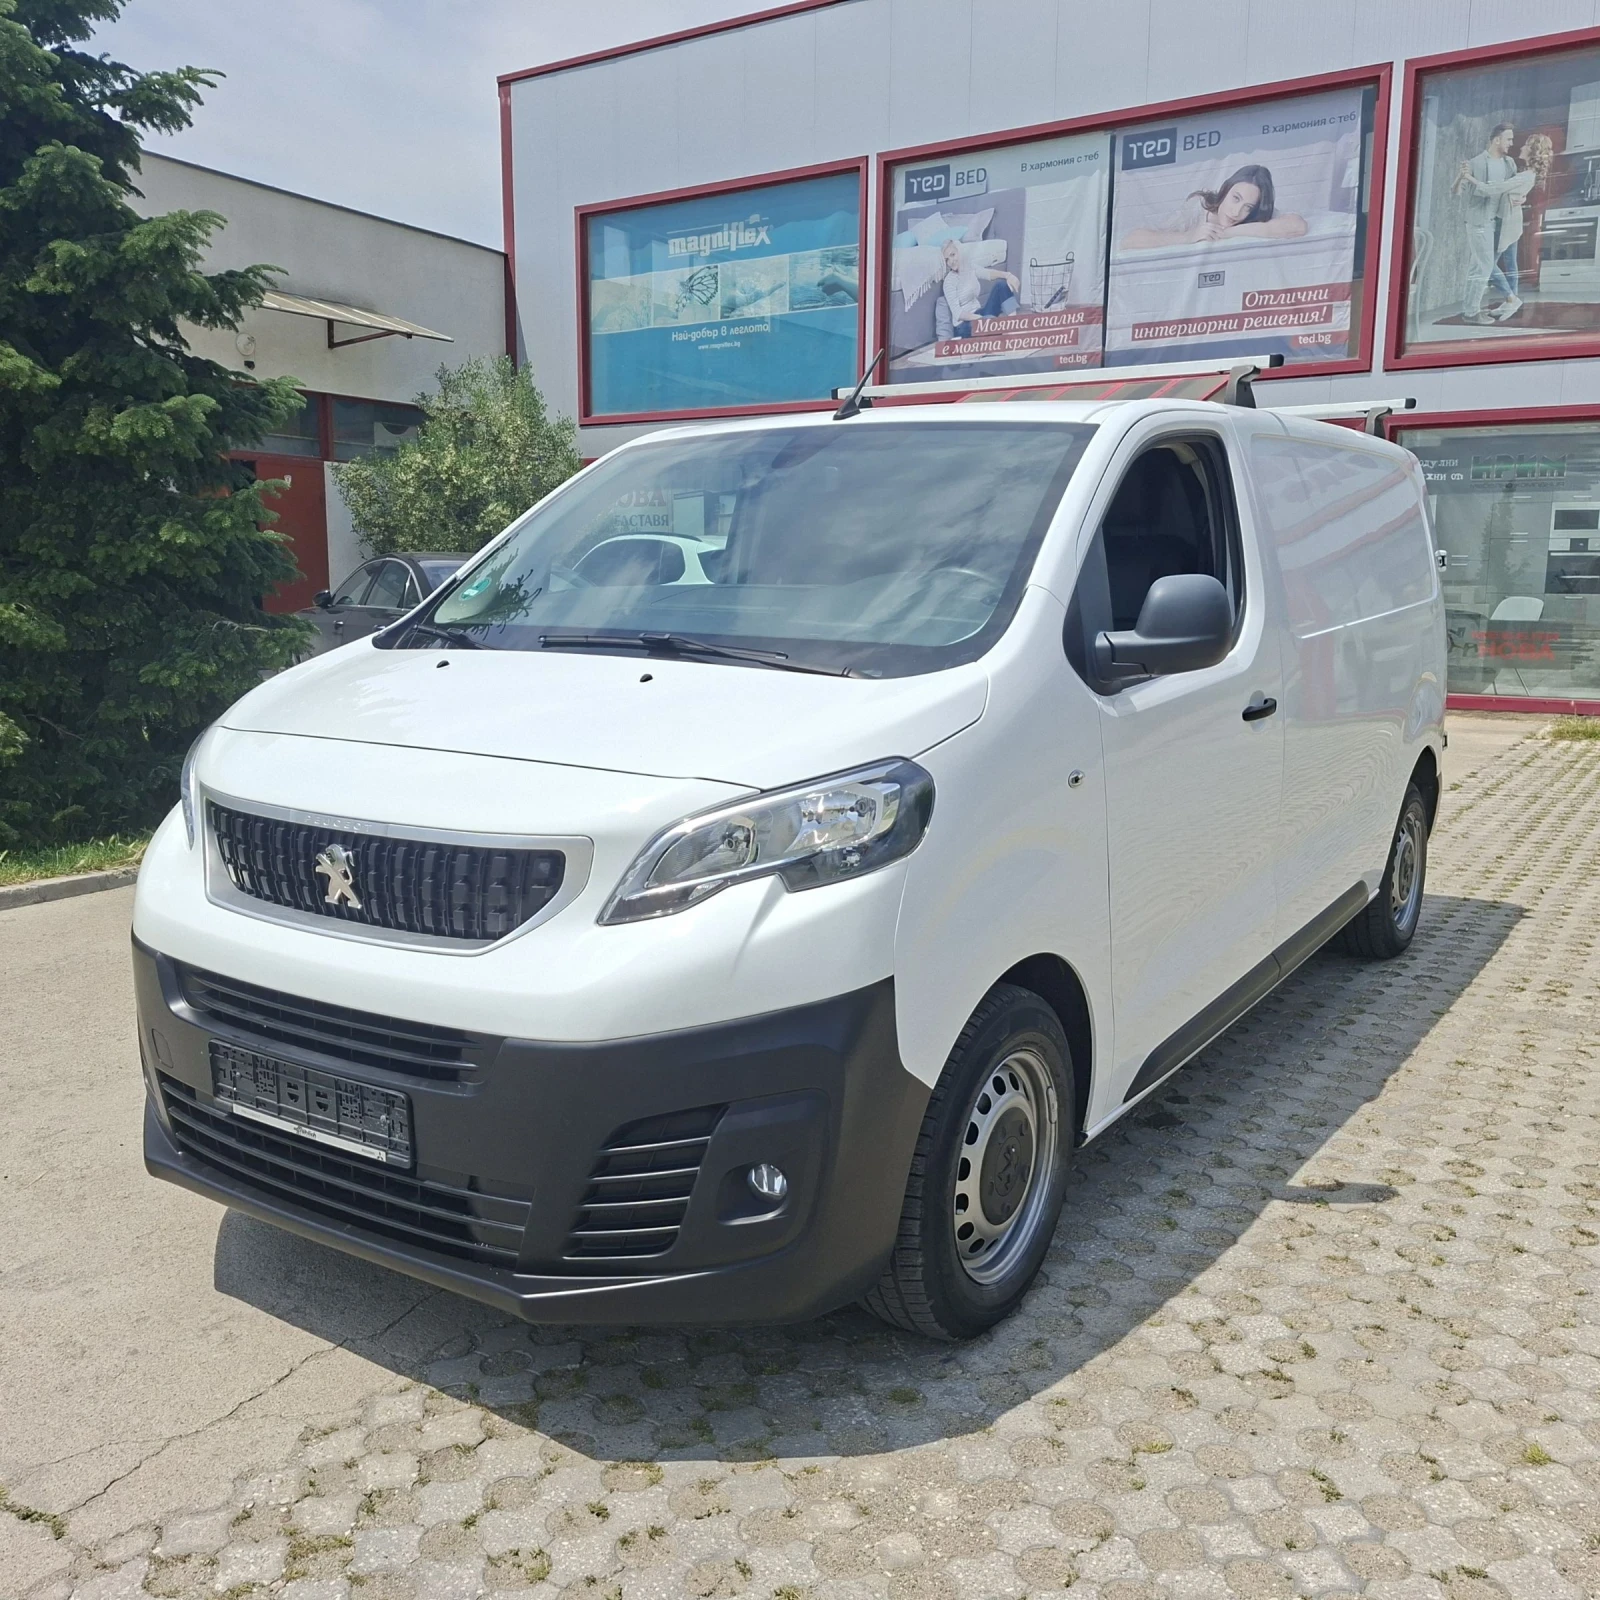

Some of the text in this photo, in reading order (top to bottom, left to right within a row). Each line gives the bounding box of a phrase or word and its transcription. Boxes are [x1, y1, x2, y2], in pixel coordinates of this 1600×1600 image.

[1262, 125, 1270, 134] В
[1272, 118, 1326, 134] хармония
[1338, 111, 1356, 123] теб
[1183, 130, 1221, 151] BED
[1021, 150, 1099, 172] В хармония с теб
[956, 168, 987, 186] BED
[668, 221, 771, 257] magniflex
[1245, 288, 1329, 307] Отлични
[975, 312, 1084, 333] Моята спалня
[1134, 306, 1327, 338] интериорни решения!
[672, 327, 718, 342] Най-добър
[730, 323, 769, 335] леглото
[1298, 333, 1331, 345] ted.bg
[942, 330, 1074, 355] е моята крепост!
[1059, 354, 1087, 364] ted.bg
[1420, 459, 1458, 469] одулни
[1423, 473, 1447, 481] хни
[1477, 641, 1555, 661] НОВА
[304, 815, 372, 833] PEUGEOT
